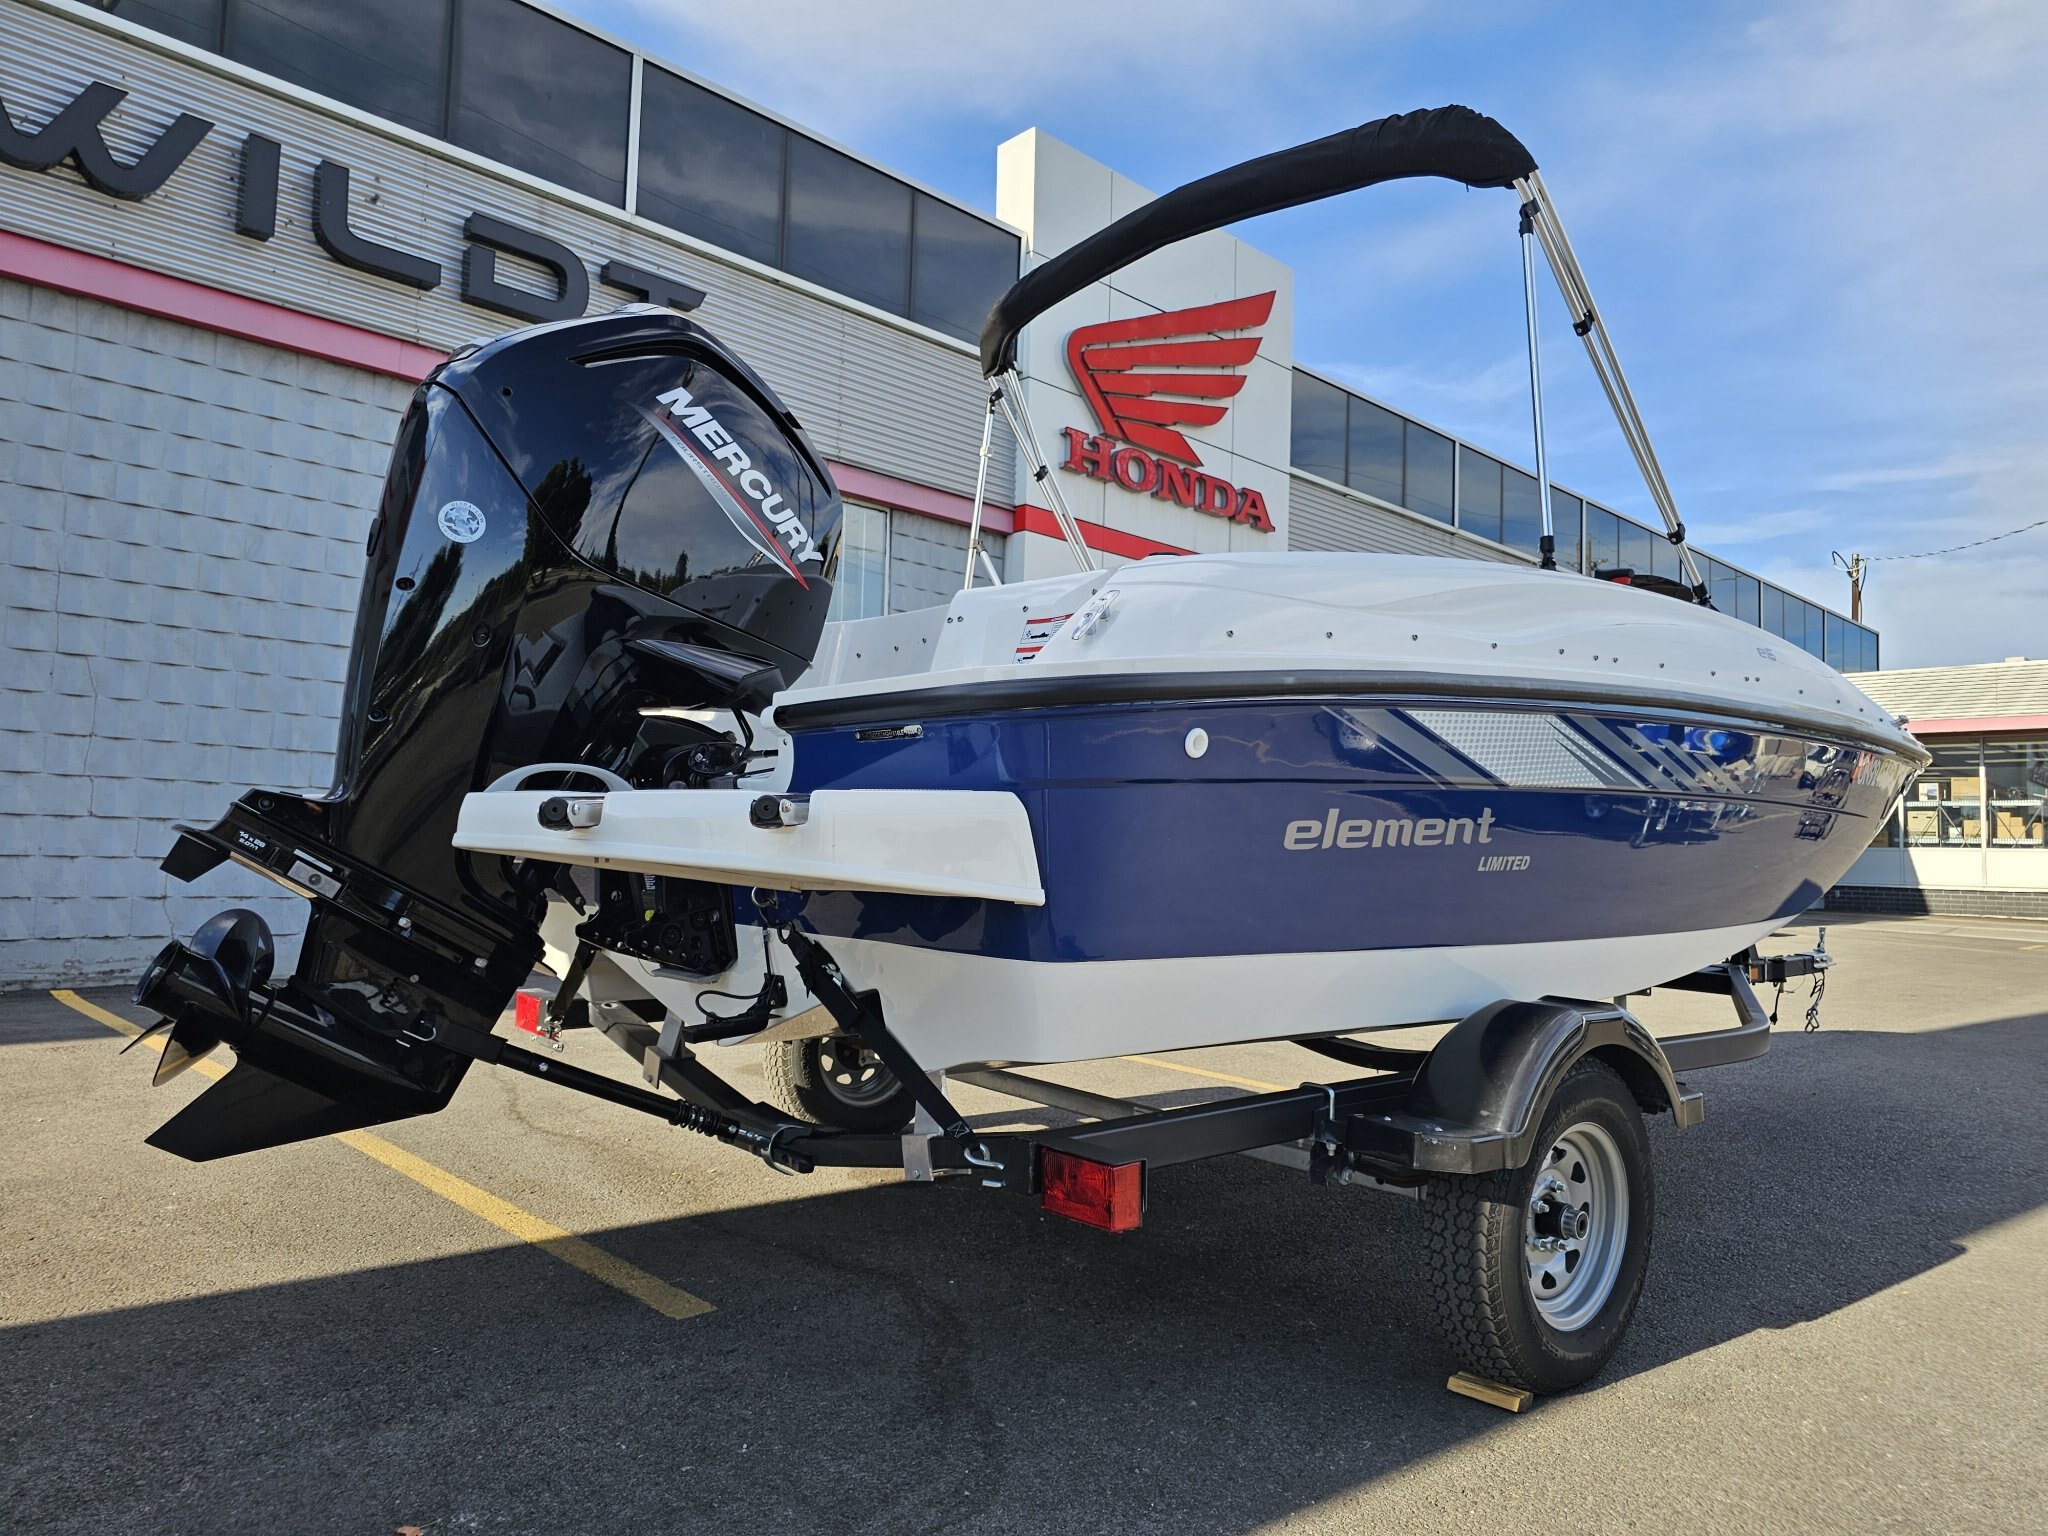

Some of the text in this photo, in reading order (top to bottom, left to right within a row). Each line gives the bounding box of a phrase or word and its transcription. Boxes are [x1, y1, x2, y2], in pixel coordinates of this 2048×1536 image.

[655, 386, 824, 563] MERCURY
[1060, 427, 1276, 533] HONDA
[1283, 807, 1496, 850] element
[1477, 855, 1531, 872] LIMITED
